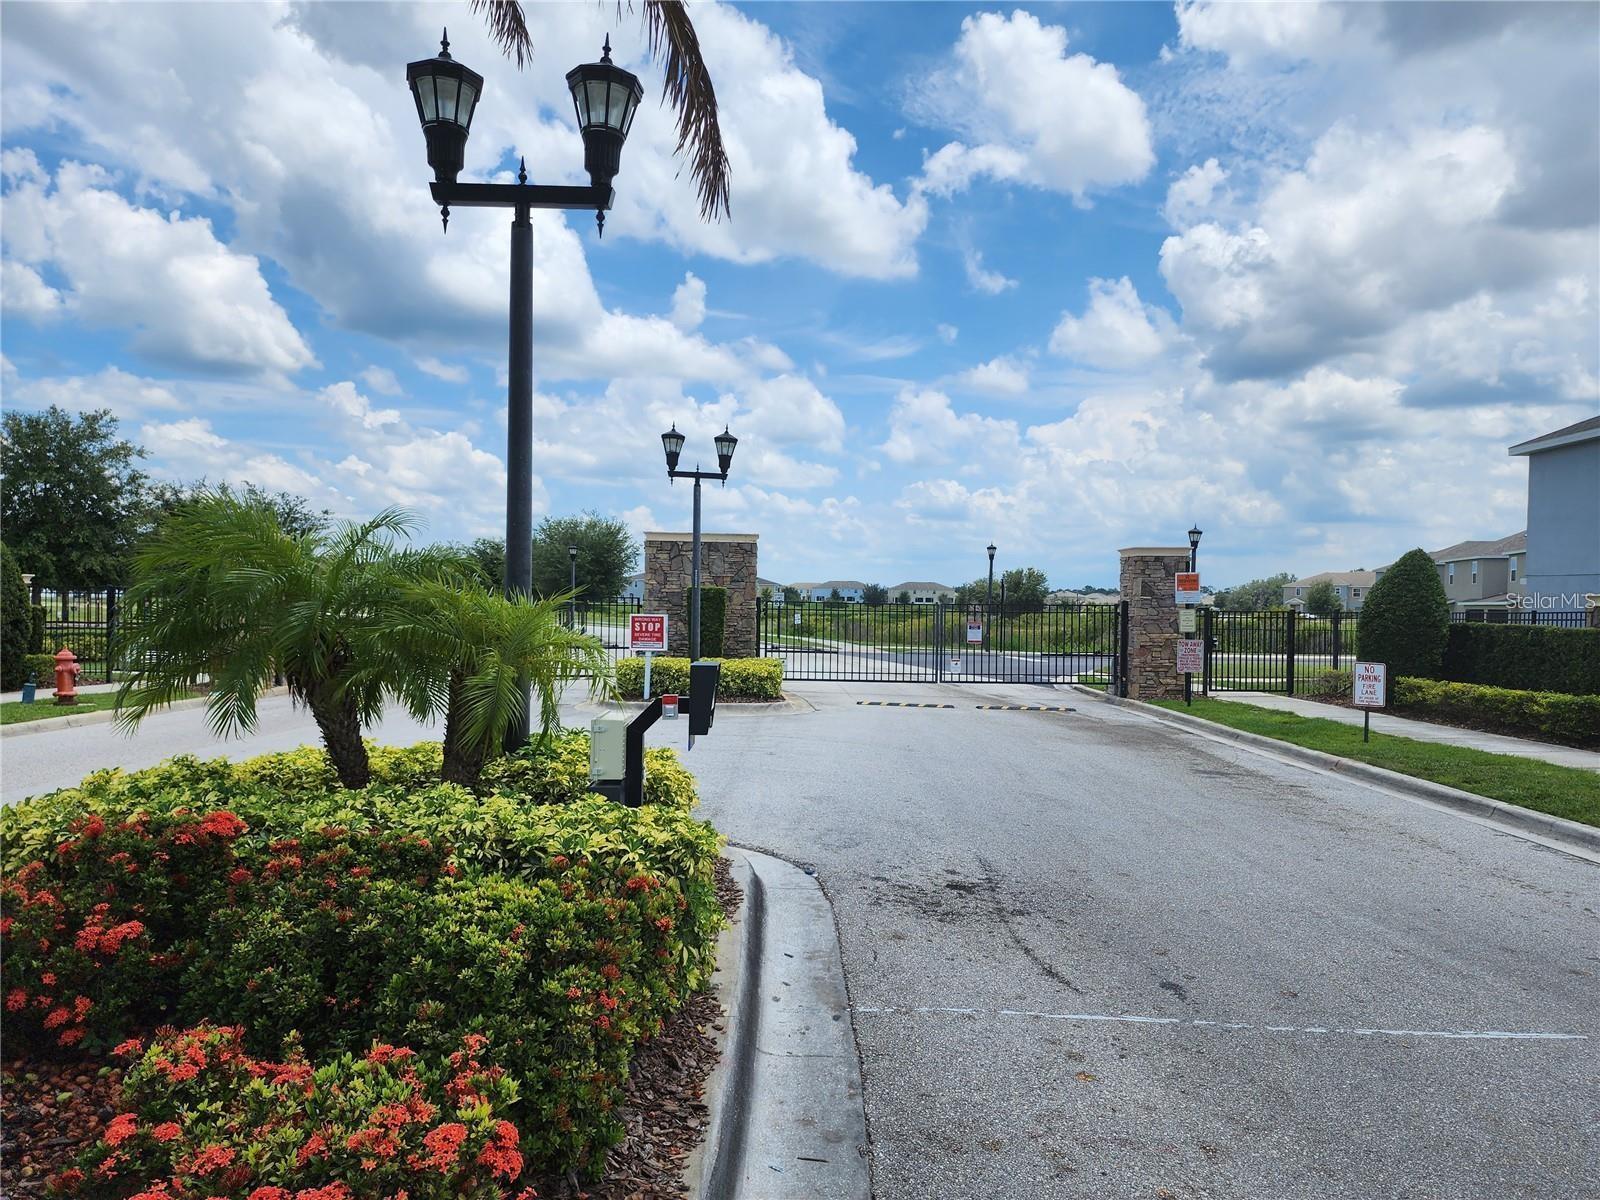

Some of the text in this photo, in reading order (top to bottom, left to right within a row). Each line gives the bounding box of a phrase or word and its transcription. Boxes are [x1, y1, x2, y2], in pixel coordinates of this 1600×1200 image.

[634, 622, 661, 632] STOP
[1364, 665, 1375, 674] NO
[1358, 674, 1382, 682] PARKING
